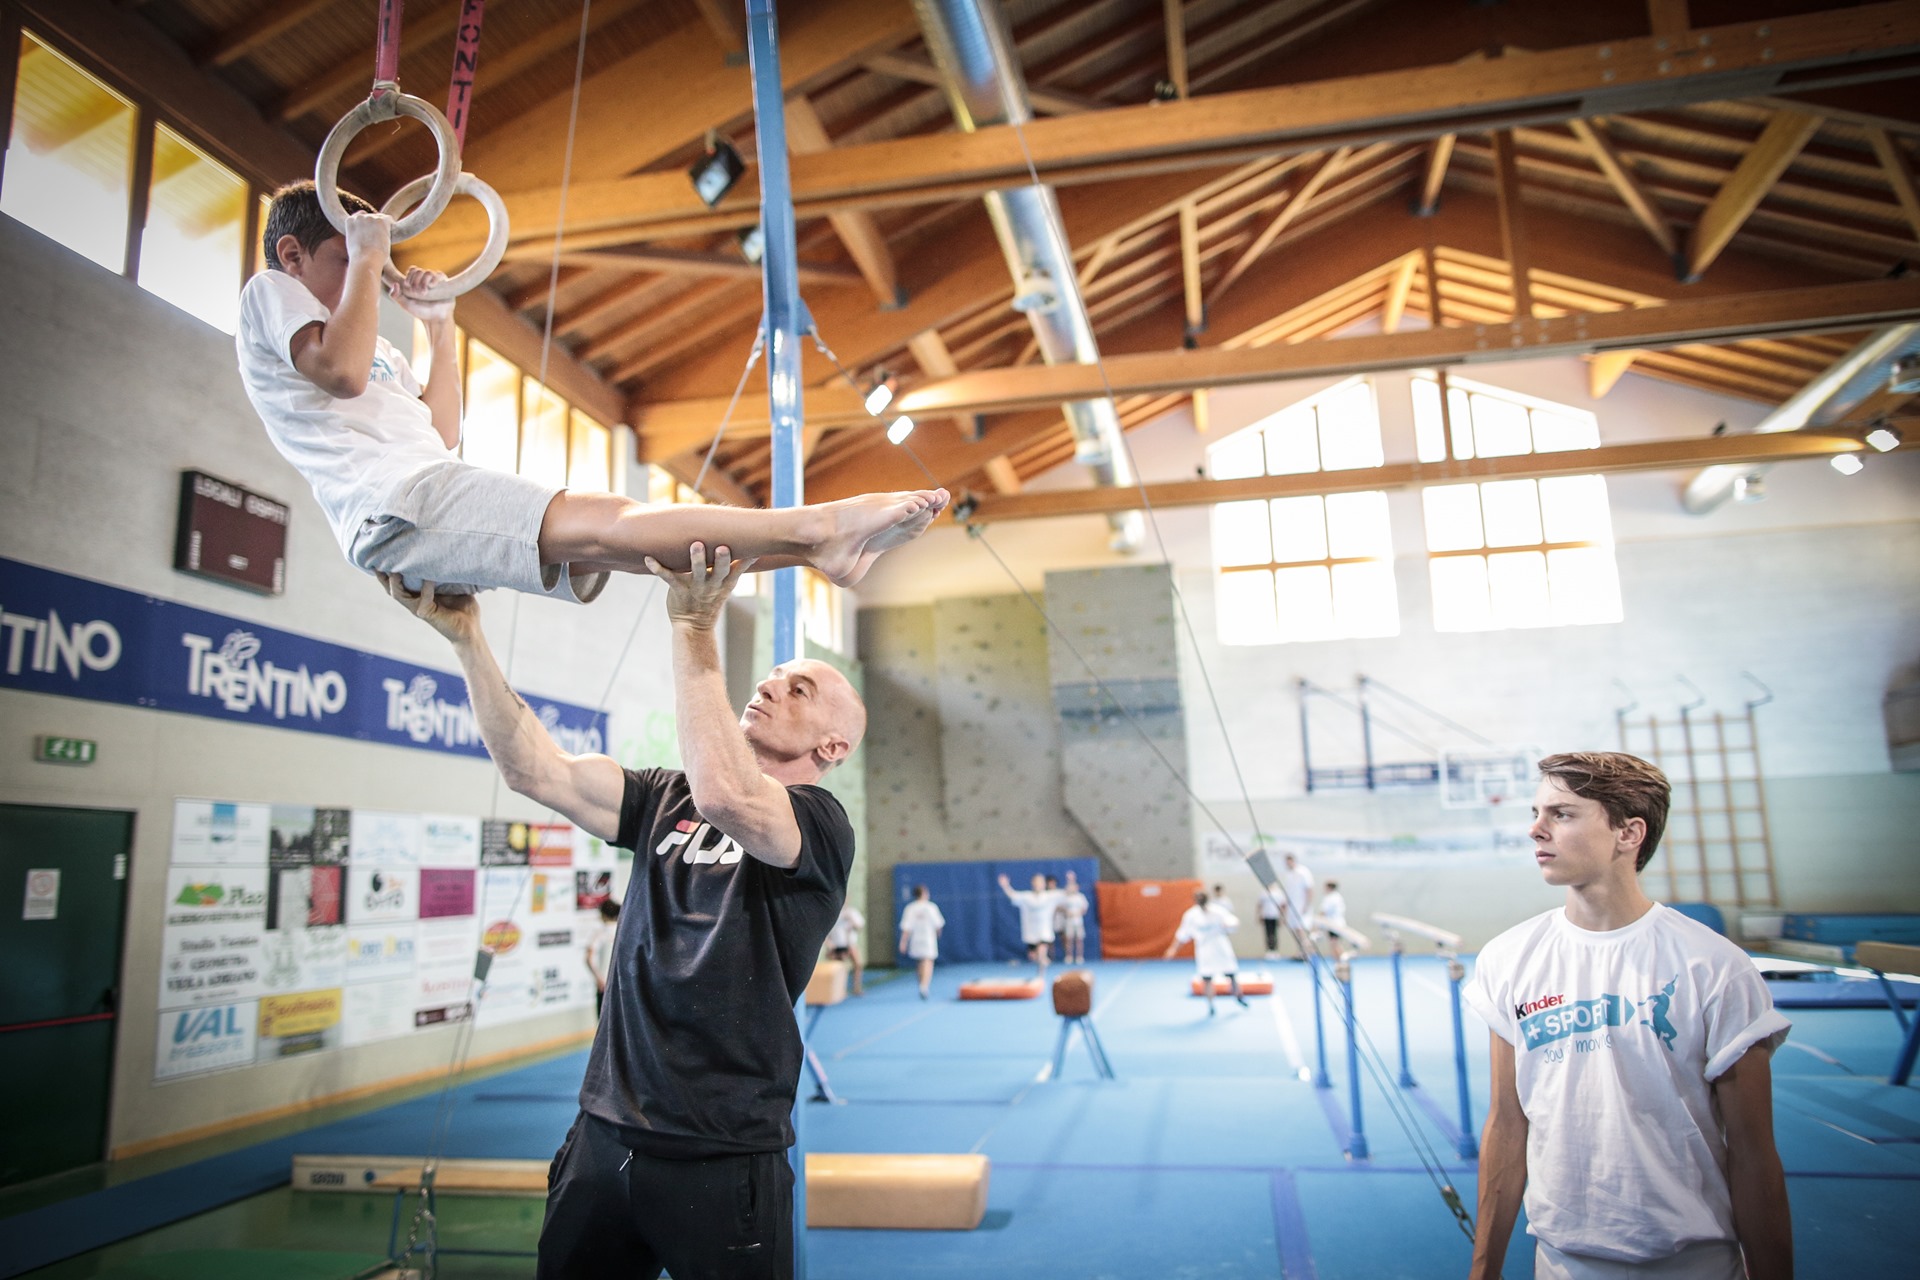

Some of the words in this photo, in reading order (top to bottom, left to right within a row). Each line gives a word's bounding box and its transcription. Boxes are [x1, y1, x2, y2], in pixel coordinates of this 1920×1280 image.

[0, 606, 122, 681] TINO
[182, 632, 348, 722] TRENTINO
[382, 678, 481, 748] TRENTIN
[173, 1007, 244, 1046] VAL
[1515, 994, 1564, 1020] Kinder
